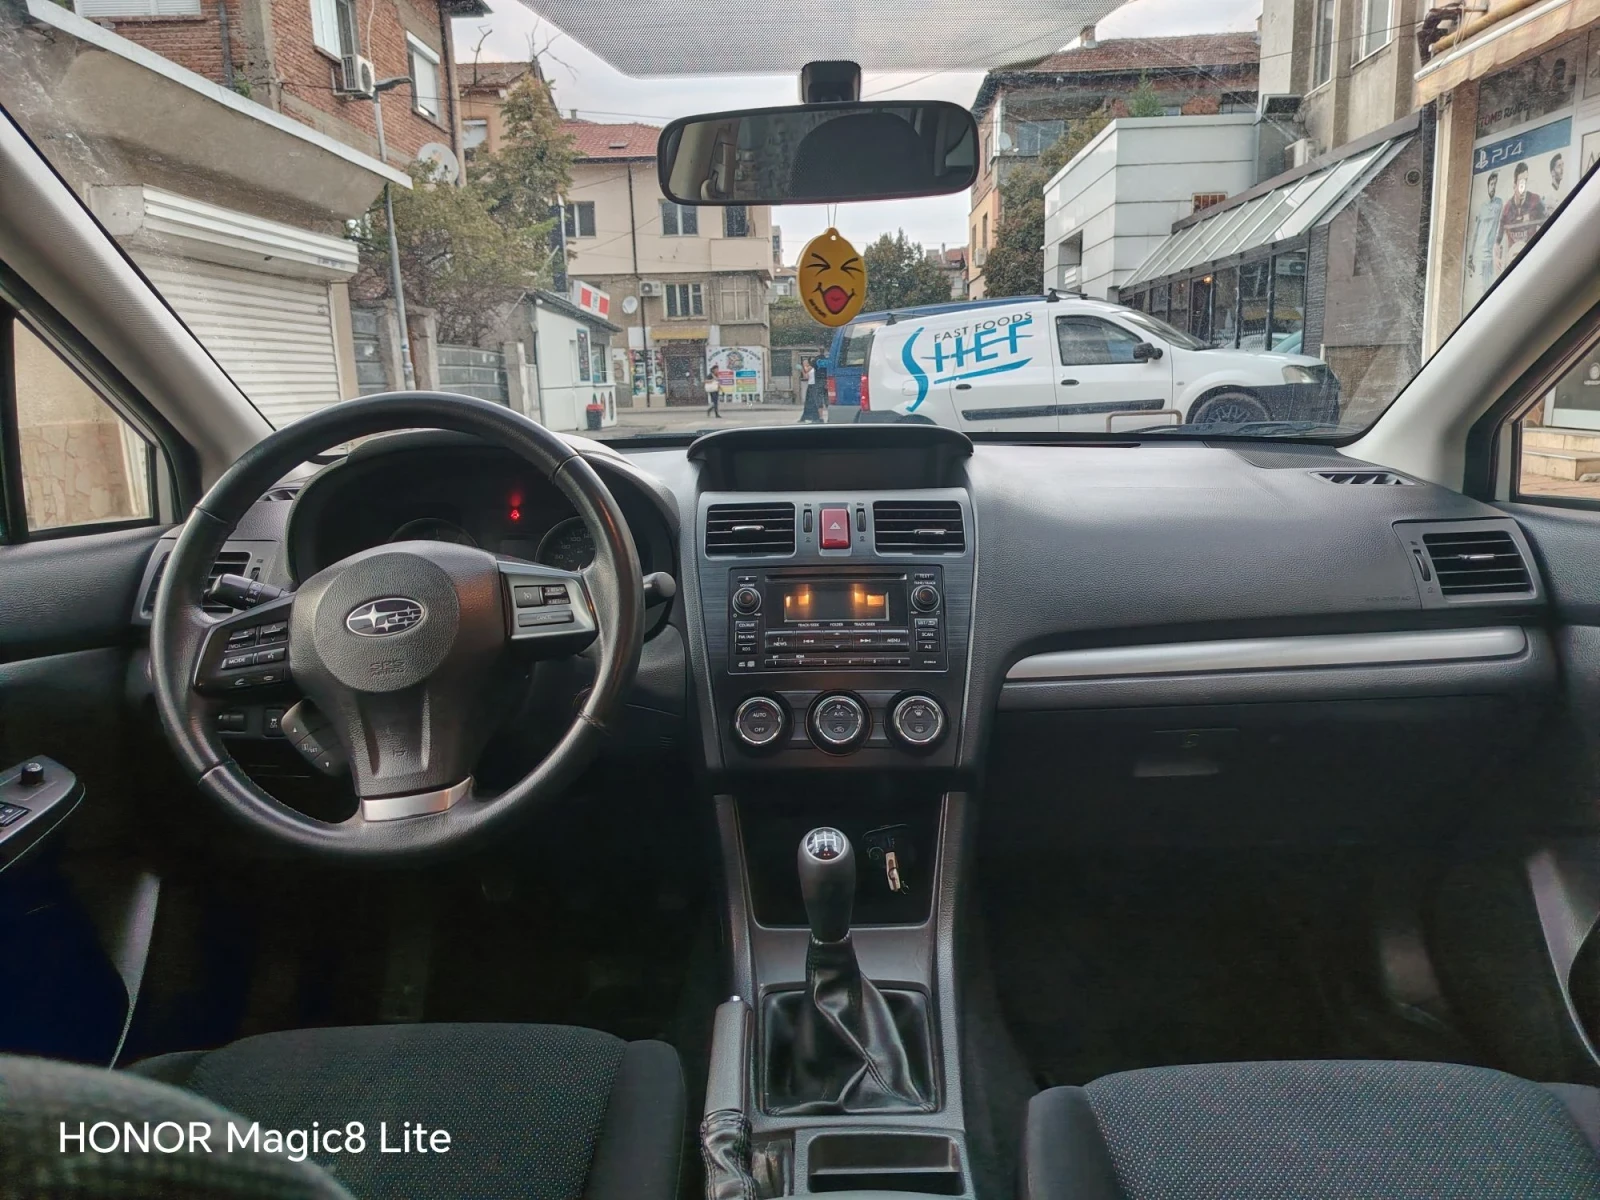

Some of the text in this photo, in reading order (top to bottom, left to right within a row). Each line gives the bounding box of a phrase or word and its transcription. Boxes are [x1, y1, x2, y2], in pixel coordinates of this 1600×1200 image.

[1480, 110, 1502, 127] TOMB
[1491, 142, 1523, 163] PS4
[934, 311, 1032, 343] FAST FOODS
[901, 326, 1033, 412] SHEF
[228, 657, 246, 665] MODE
